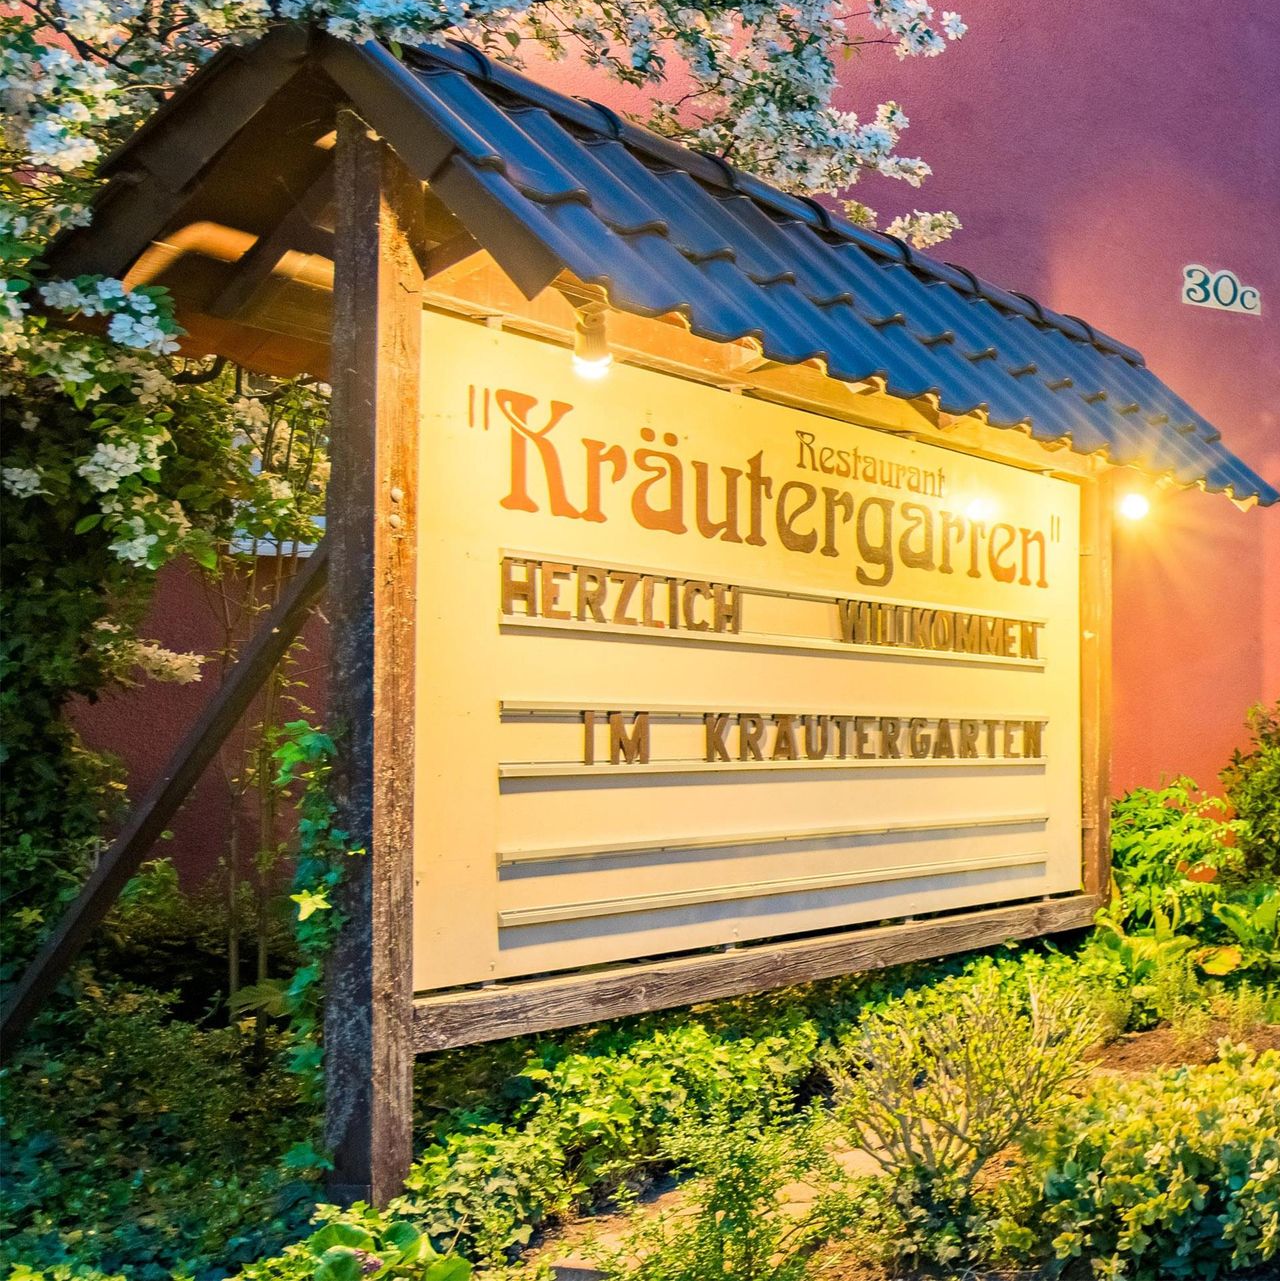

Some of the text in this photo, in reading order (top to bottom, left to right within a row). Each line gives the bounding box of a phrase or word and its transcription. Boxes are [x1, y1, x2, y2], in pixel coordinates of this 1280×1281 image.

[1185, 267, 1258, 311] 30c
[795, 429, 946, 499] Restaurant
[501, 557, 1041, 660] HERZLICH WILLKOMMEN
[583, 710, 650, 766] IM
